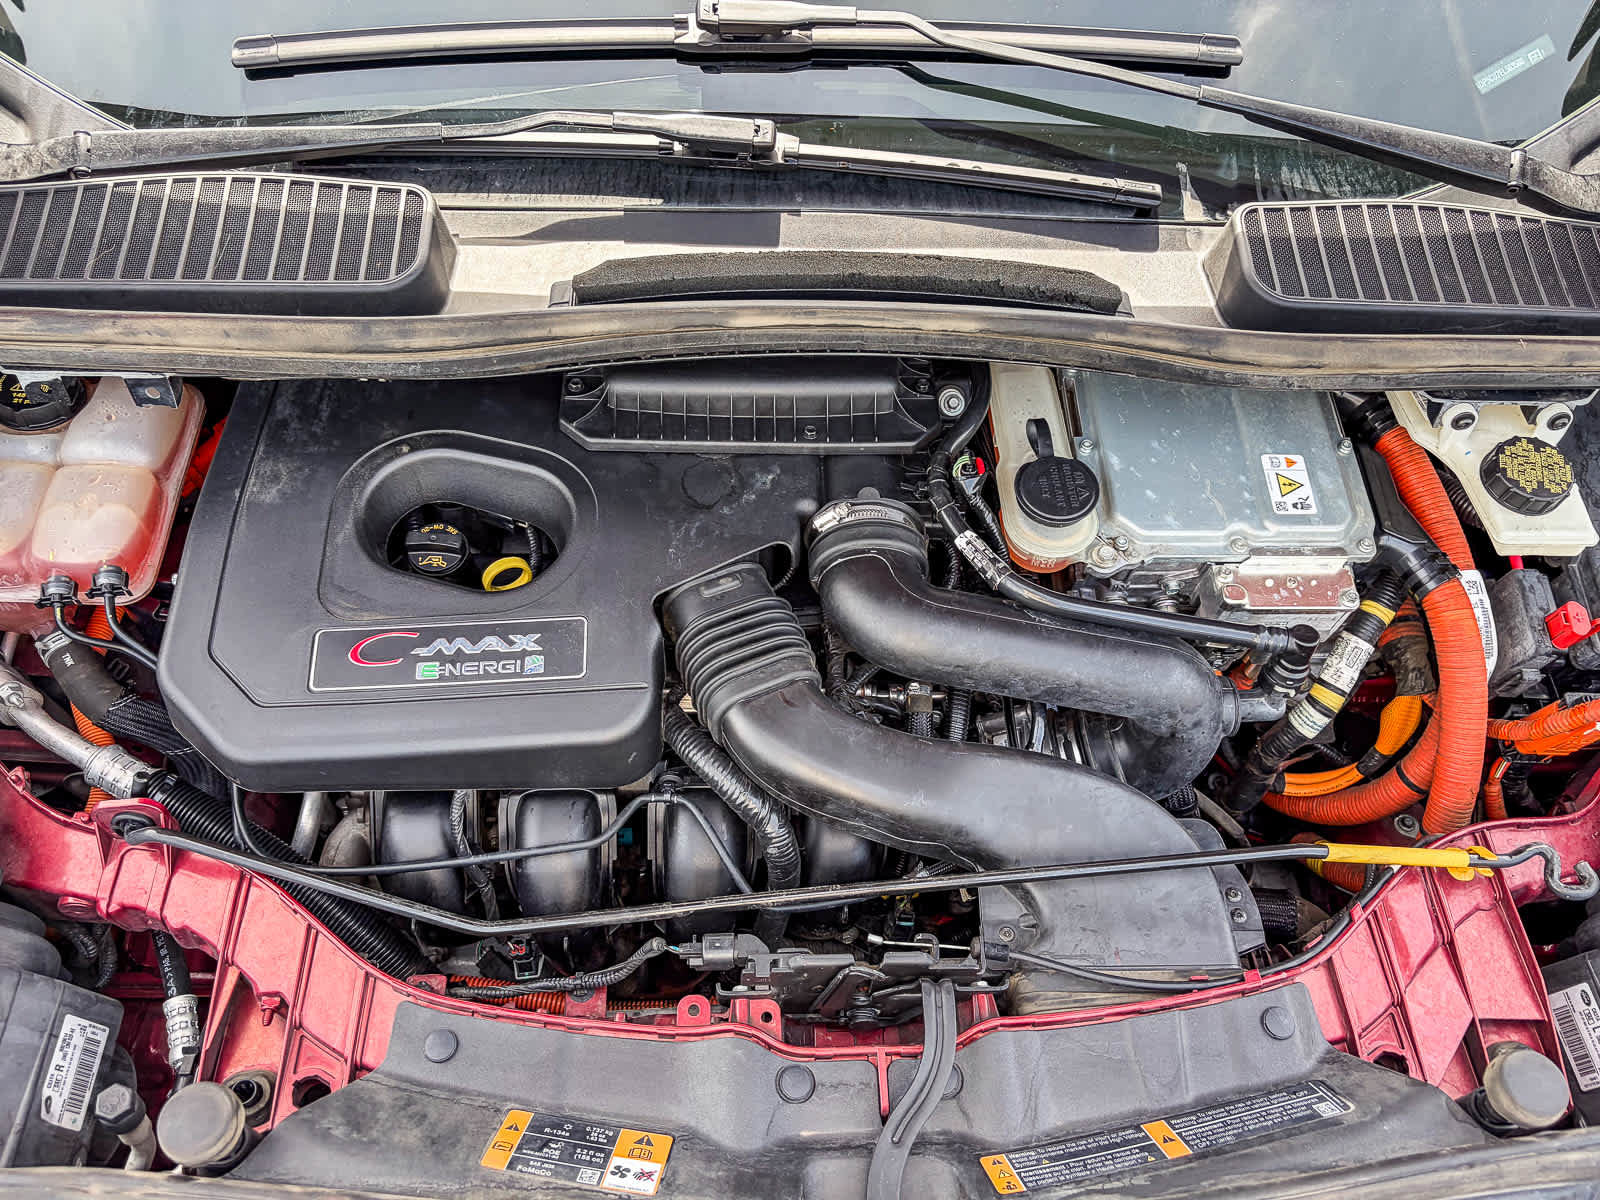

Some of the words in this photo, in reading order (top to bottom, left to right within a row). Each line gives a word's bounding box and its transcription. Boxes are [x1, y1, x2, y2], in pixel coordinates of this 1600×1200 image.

[447, 525, 459, 535] SAE
[416, 660, 521, 680] ENERGI
[55, 1064, 65, 1073] R
[544, 1127, 570, 1135] R-134a
[516, 1165, 552, 1175] FoMoCo
